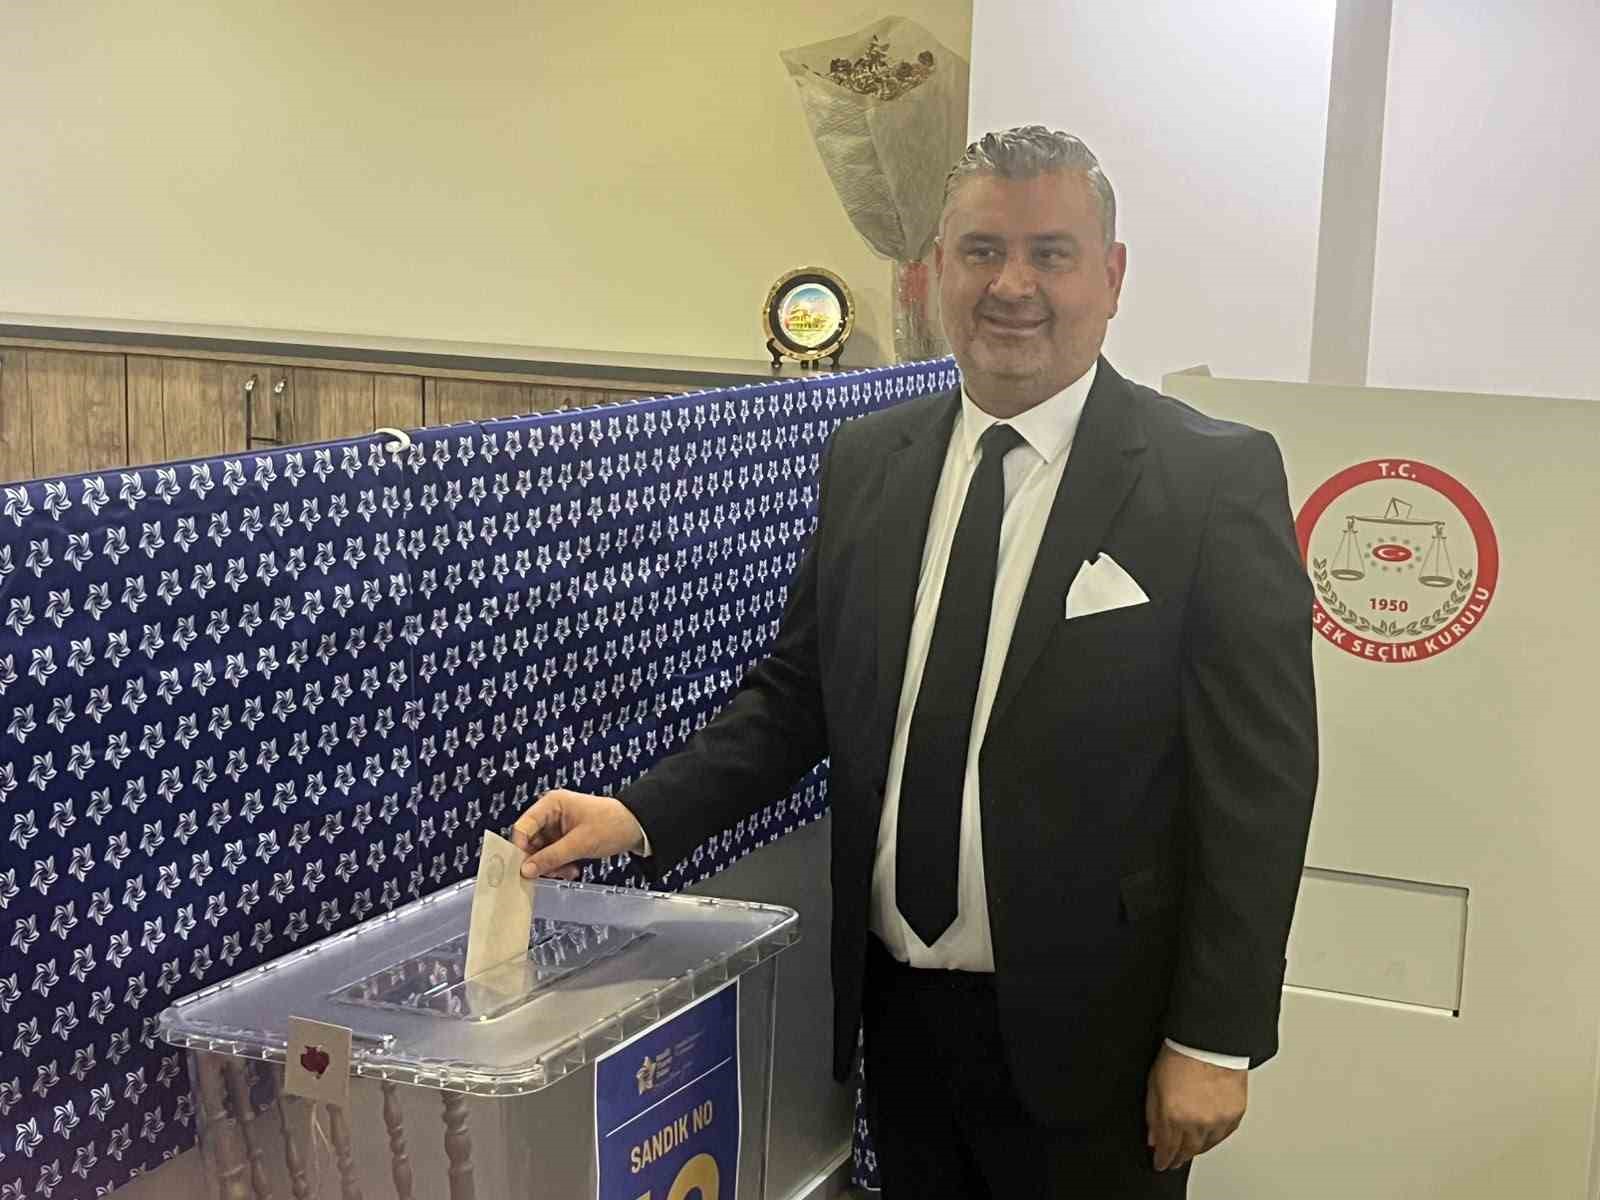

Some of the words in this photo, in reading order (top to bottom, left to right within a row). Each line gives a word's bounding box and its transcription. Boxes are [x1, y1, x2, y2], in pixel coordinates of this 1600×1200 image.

[1378, 462, 1416, 479] T.C.
[1312, 603, 1347, 645] SEK
[1351, 639, 1417, 662] SEÇİM
[1424, 586, 1489, 653] KURULU
[1369, 598, 1409, 613] 1950
[630, 1113, 689, 1174] SANDIK
[692, 1099, 713, 1133] NO
